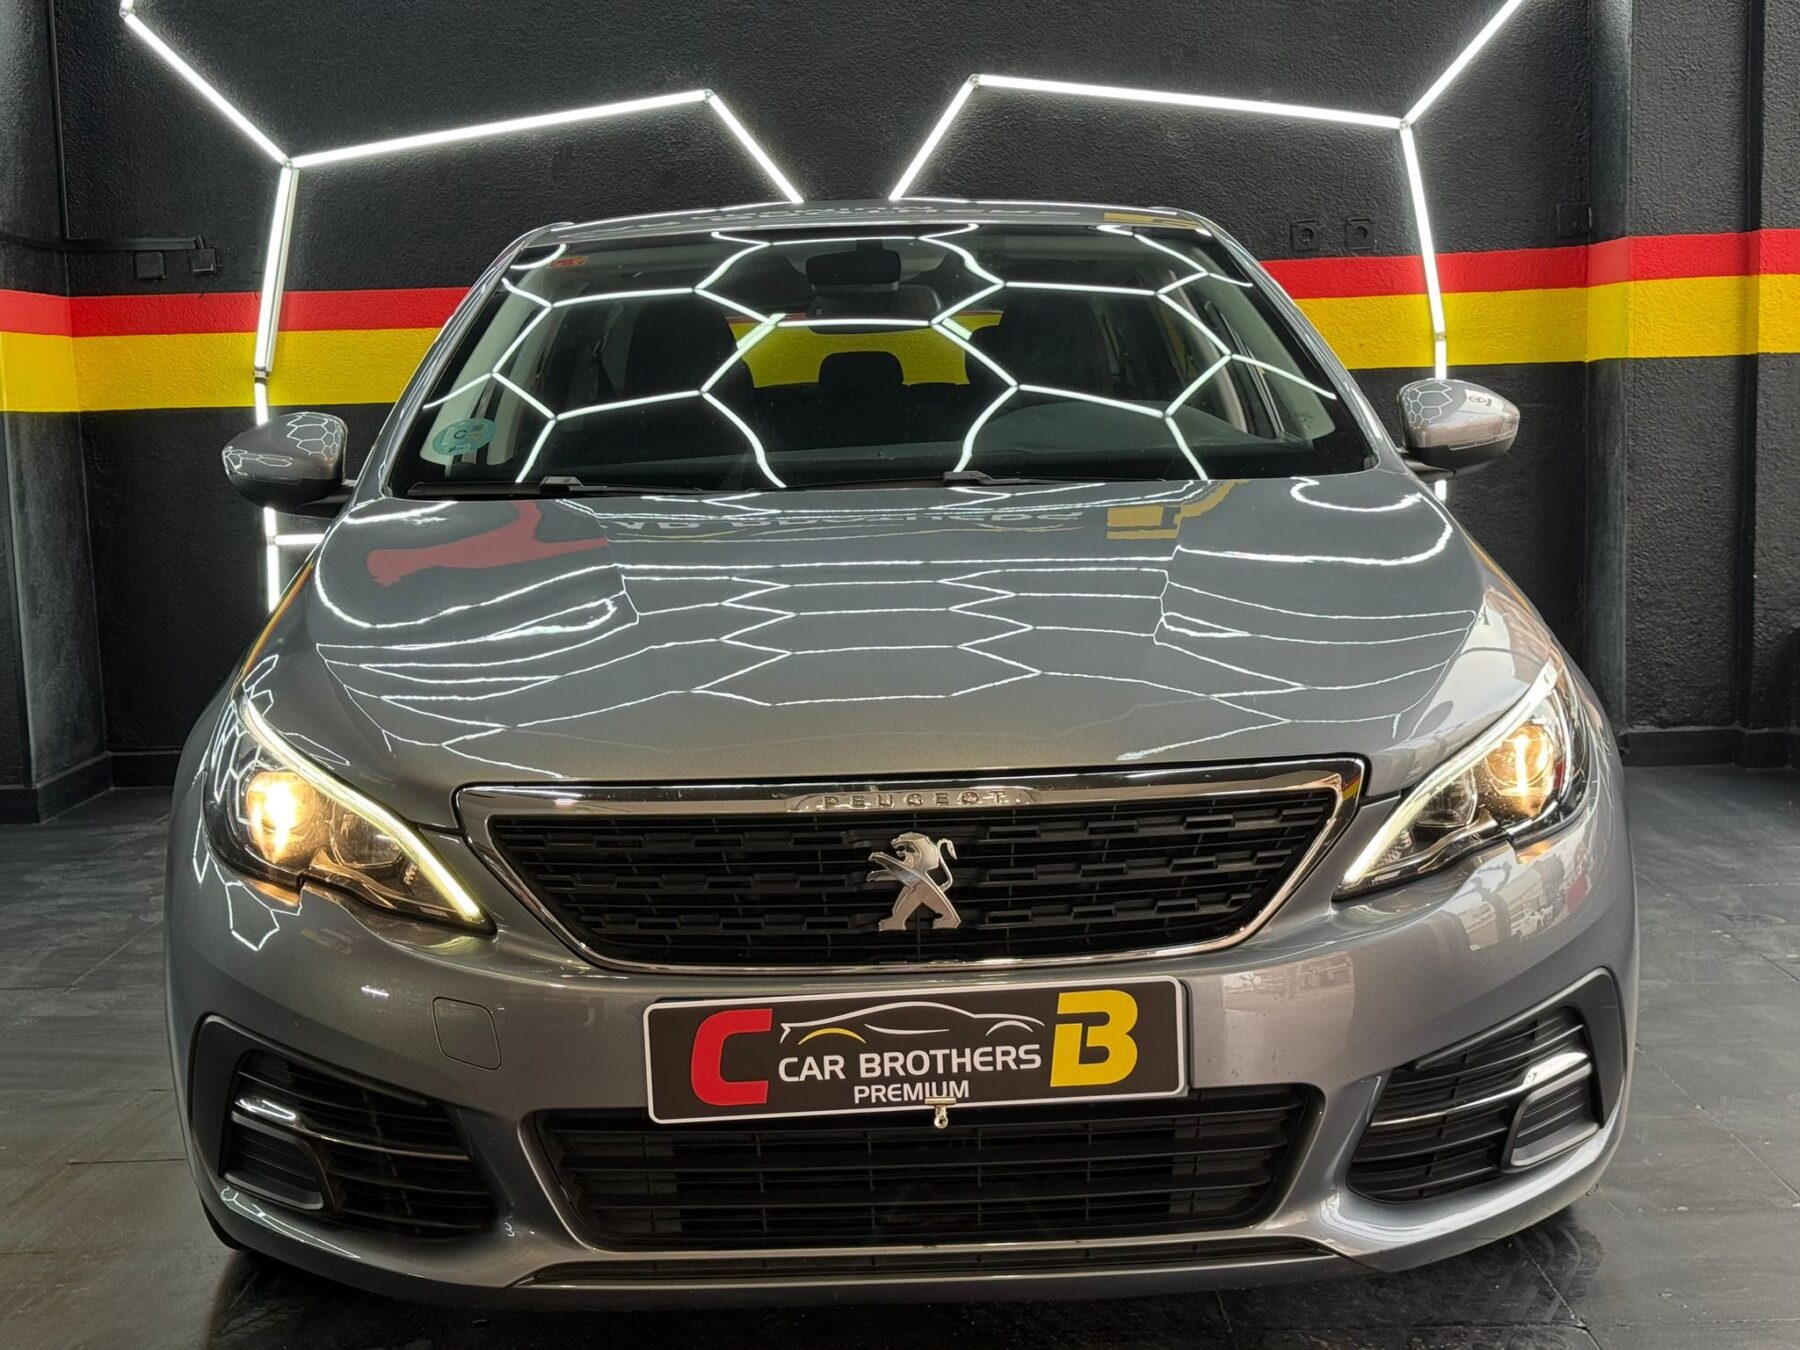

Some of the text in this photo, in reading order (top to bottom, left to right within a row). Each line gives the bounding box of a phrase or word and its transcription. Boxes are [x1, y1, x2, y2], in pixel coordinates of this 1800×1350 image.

[823, 790, 1007, 810] PEUGEOT
[690, 1008, 773, 1106] C
[1049, 989, 1139, 1088] B
[778, 1043, 1042, 1083] CAR BROTHERS
[853, 1080, 970, 1105] PREMIUM
